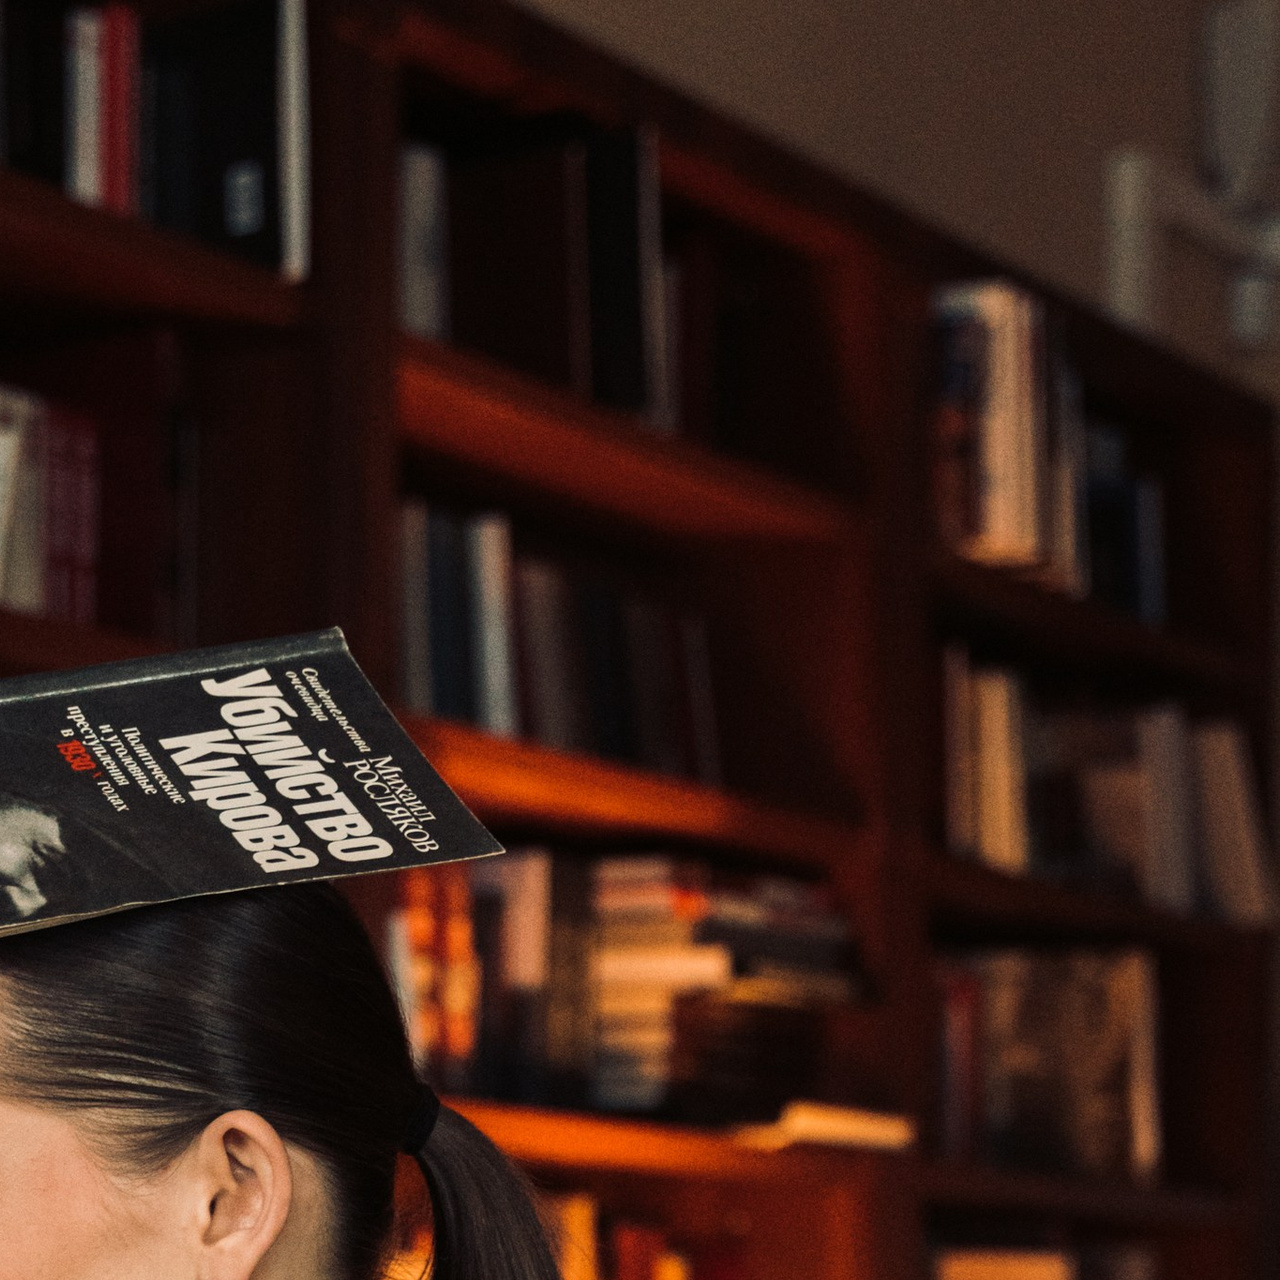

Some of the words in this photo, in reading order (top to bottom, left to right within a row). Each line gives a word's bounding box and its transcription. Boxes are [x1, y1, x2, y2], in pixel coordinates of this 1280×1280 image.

[98, 723, 114, 734] и
[285, 670, 329, 723] очевидца
[301, 666, 371, 753] Свидетельства
[60, 728, 75, 738] в
[97, 780, 130, 812] годах
[66, 705, 130, 786] преступления
[100, 734, 158, 795] уголовные
[121, 727, 186, 804] Политические
[157, 728, 320, 874] Кирова
[342, 758, 440, 854] РОСЛЯКОВ
[367, 754, 437, 823] Михаил
